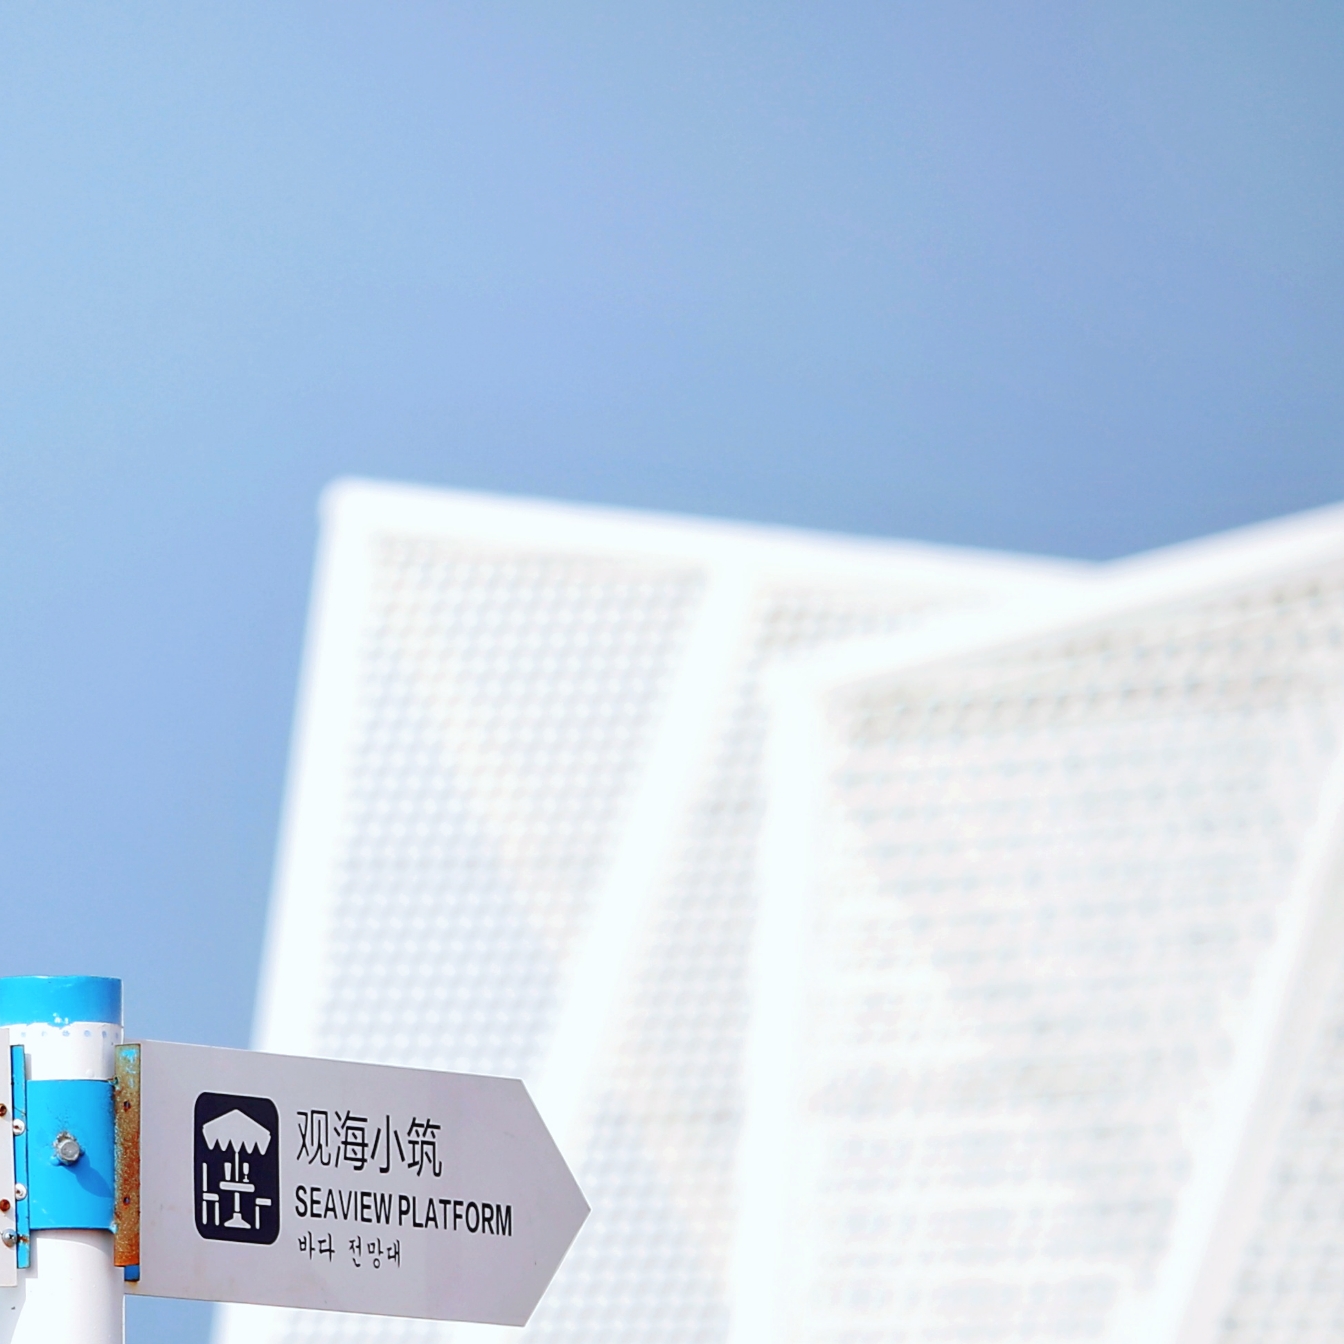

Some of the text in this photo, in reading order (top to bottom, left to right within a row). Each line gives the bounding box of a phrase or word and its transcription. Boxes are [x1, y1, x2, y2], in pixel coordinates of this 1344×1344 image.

[296, 1109, 443, 1178] 观海小筑
[295, 1184, 512, 1237] SEAVIEW PLATFORM
[297, 1230, 401, 1269] 바다 전망대
